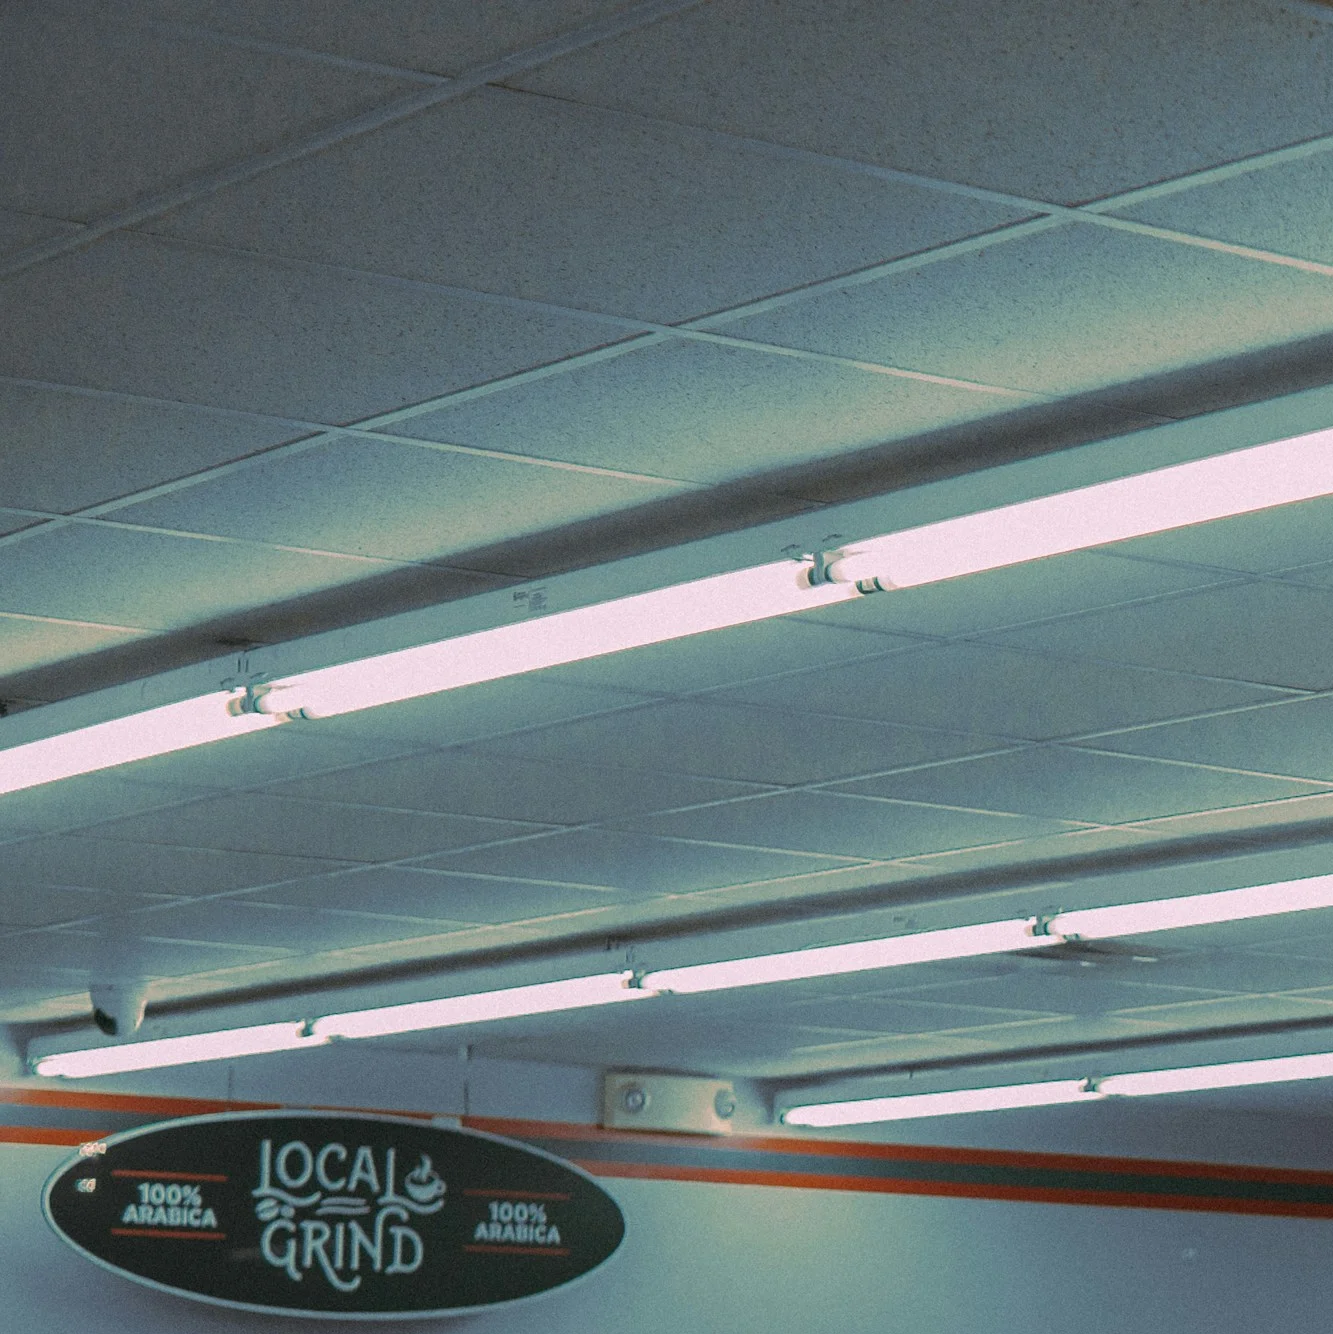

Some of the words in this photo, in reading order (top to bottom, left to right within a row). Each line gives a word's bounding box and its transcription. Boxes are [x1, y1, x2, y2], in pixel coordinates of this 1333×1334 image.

[252, 1139, 445, 1213] LOCAL
[138, 1182, 203, 1206] 100%
[122, 1203, 218, 1229] ARABICA
[488, 1200, 547, 1225] 100%
[474, 1223, 562, 1246] ARABICA
[258, 1205, 424, 1291] GRIND
